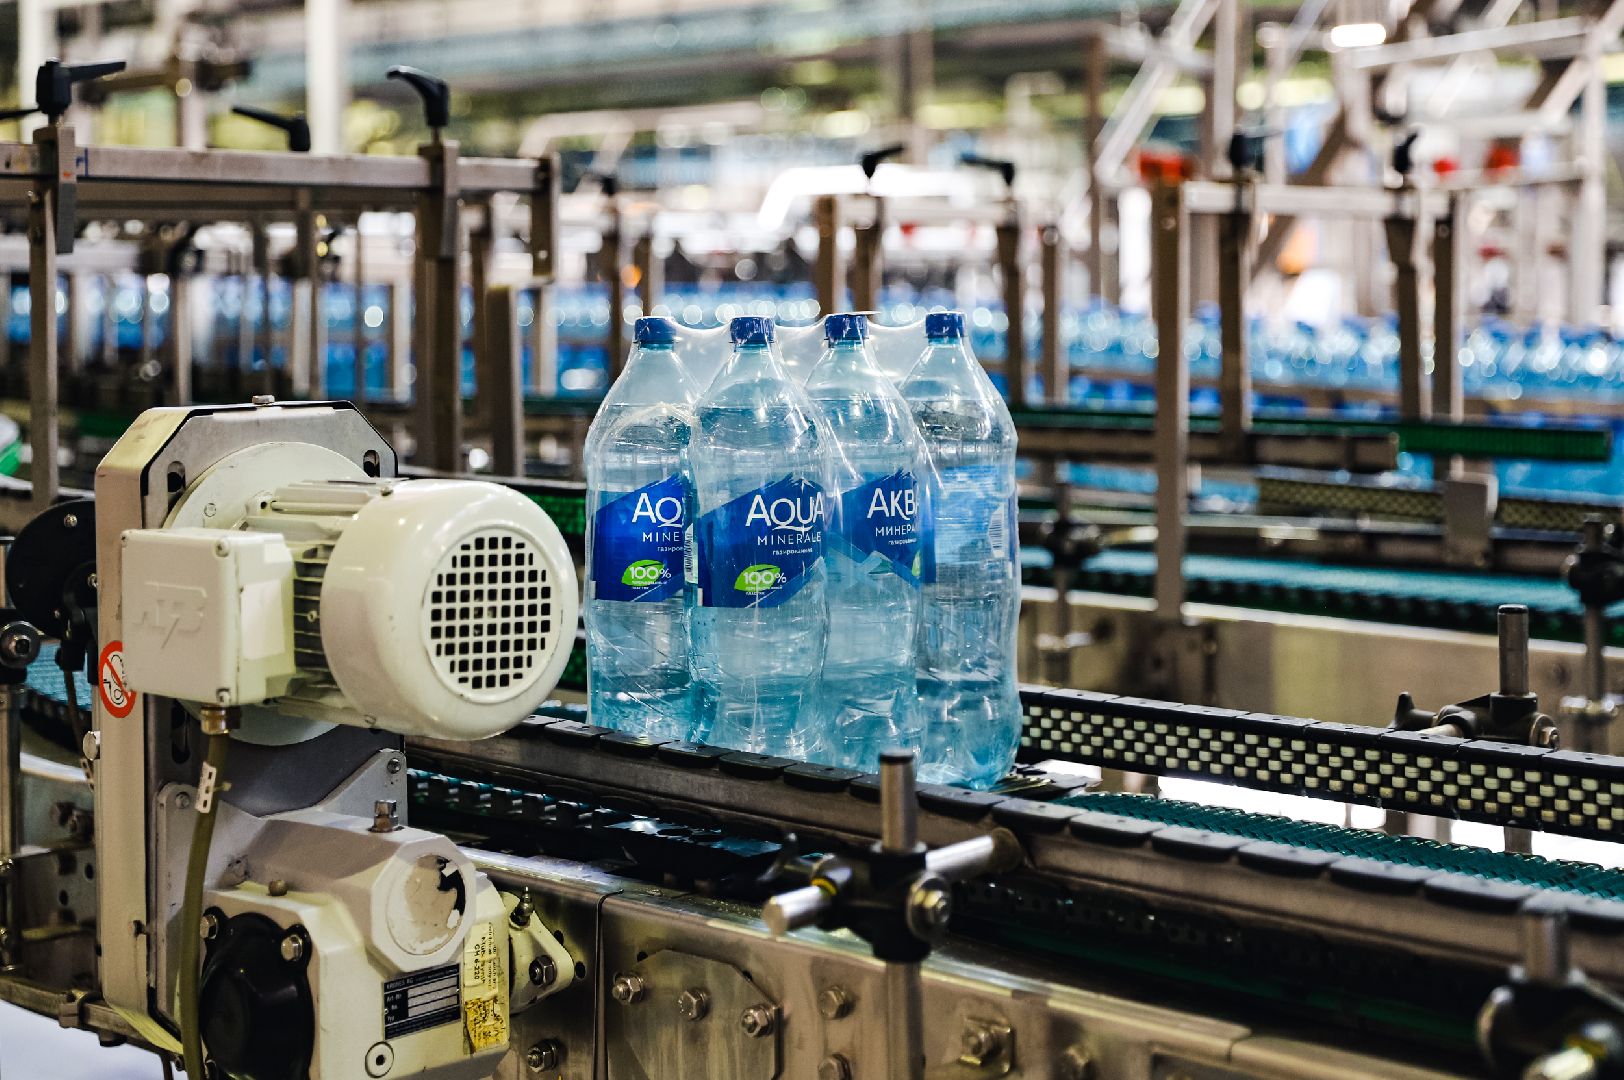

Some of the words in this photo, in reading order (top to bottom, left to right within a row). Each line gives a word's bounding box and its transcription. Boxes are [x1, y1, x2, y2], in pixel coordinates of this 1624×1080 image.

[745, 491, 824, 532] AQUA
[757, 531, 822, 546] MINERALE
[629, 566, 672, 580] 100%
[743, 570, 787, 585] 100%
